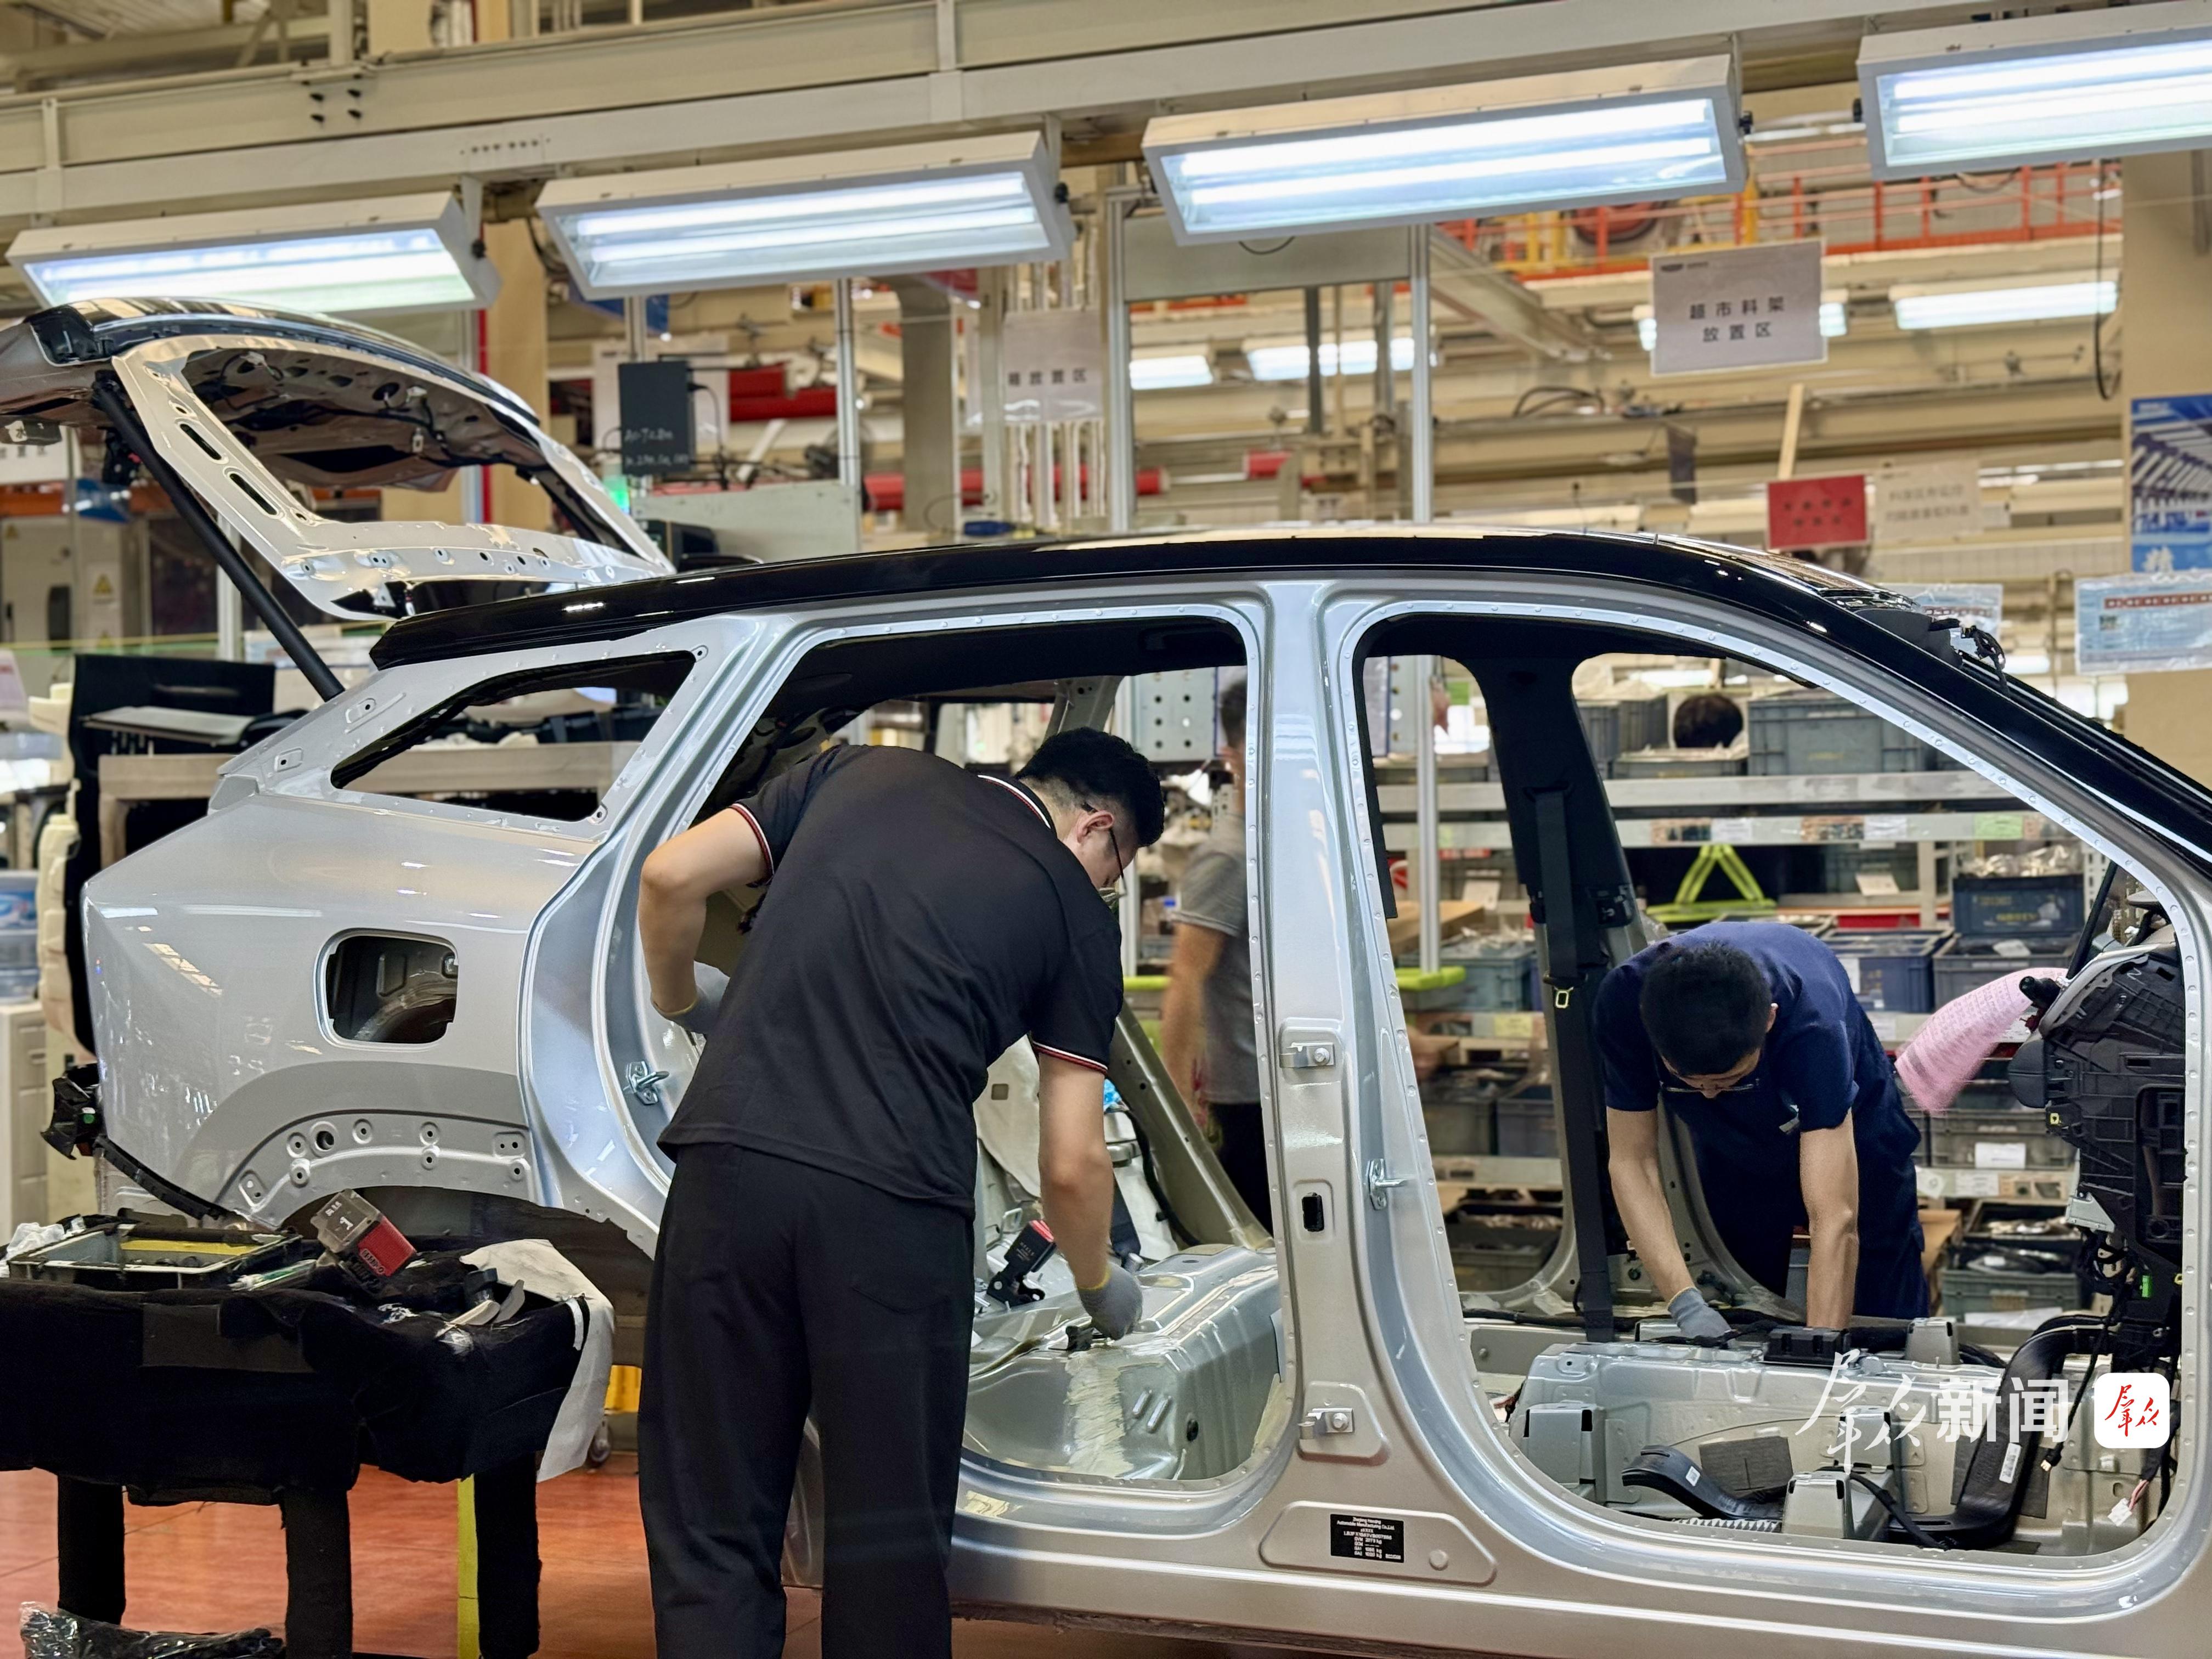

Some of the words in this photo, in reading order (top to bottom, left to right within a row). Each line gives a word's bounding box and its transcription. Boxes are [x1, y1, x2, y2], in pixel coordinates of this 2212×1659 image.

[1689, 297, 1785, 319] 超市料架
[1703, 322, 1772, 343] 放置区
